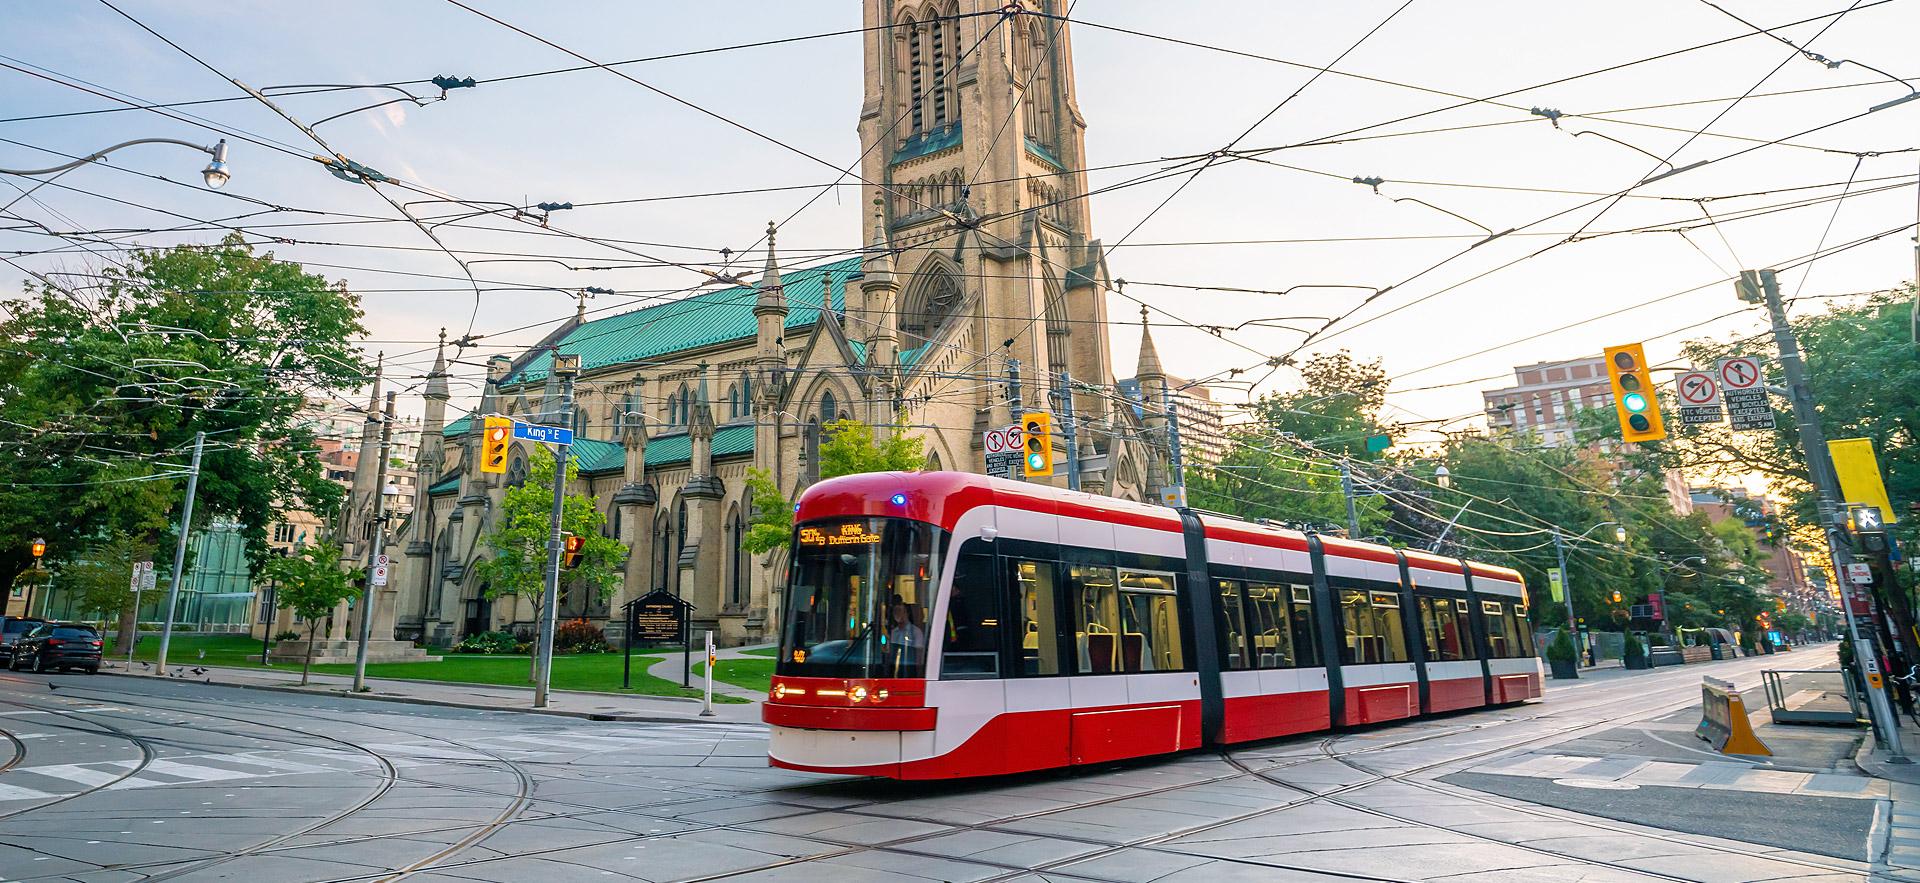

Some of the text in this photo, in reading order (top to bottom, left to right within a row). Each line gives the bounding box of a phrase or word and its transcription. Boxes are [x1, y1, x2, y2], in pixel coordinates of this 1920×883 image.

[1726, 388, 1764, 396] AUTHORIZED
[528, 428, 546, 440] King
[554, 430, 559, 440] E
[860, 534, 880, 543] Gate
